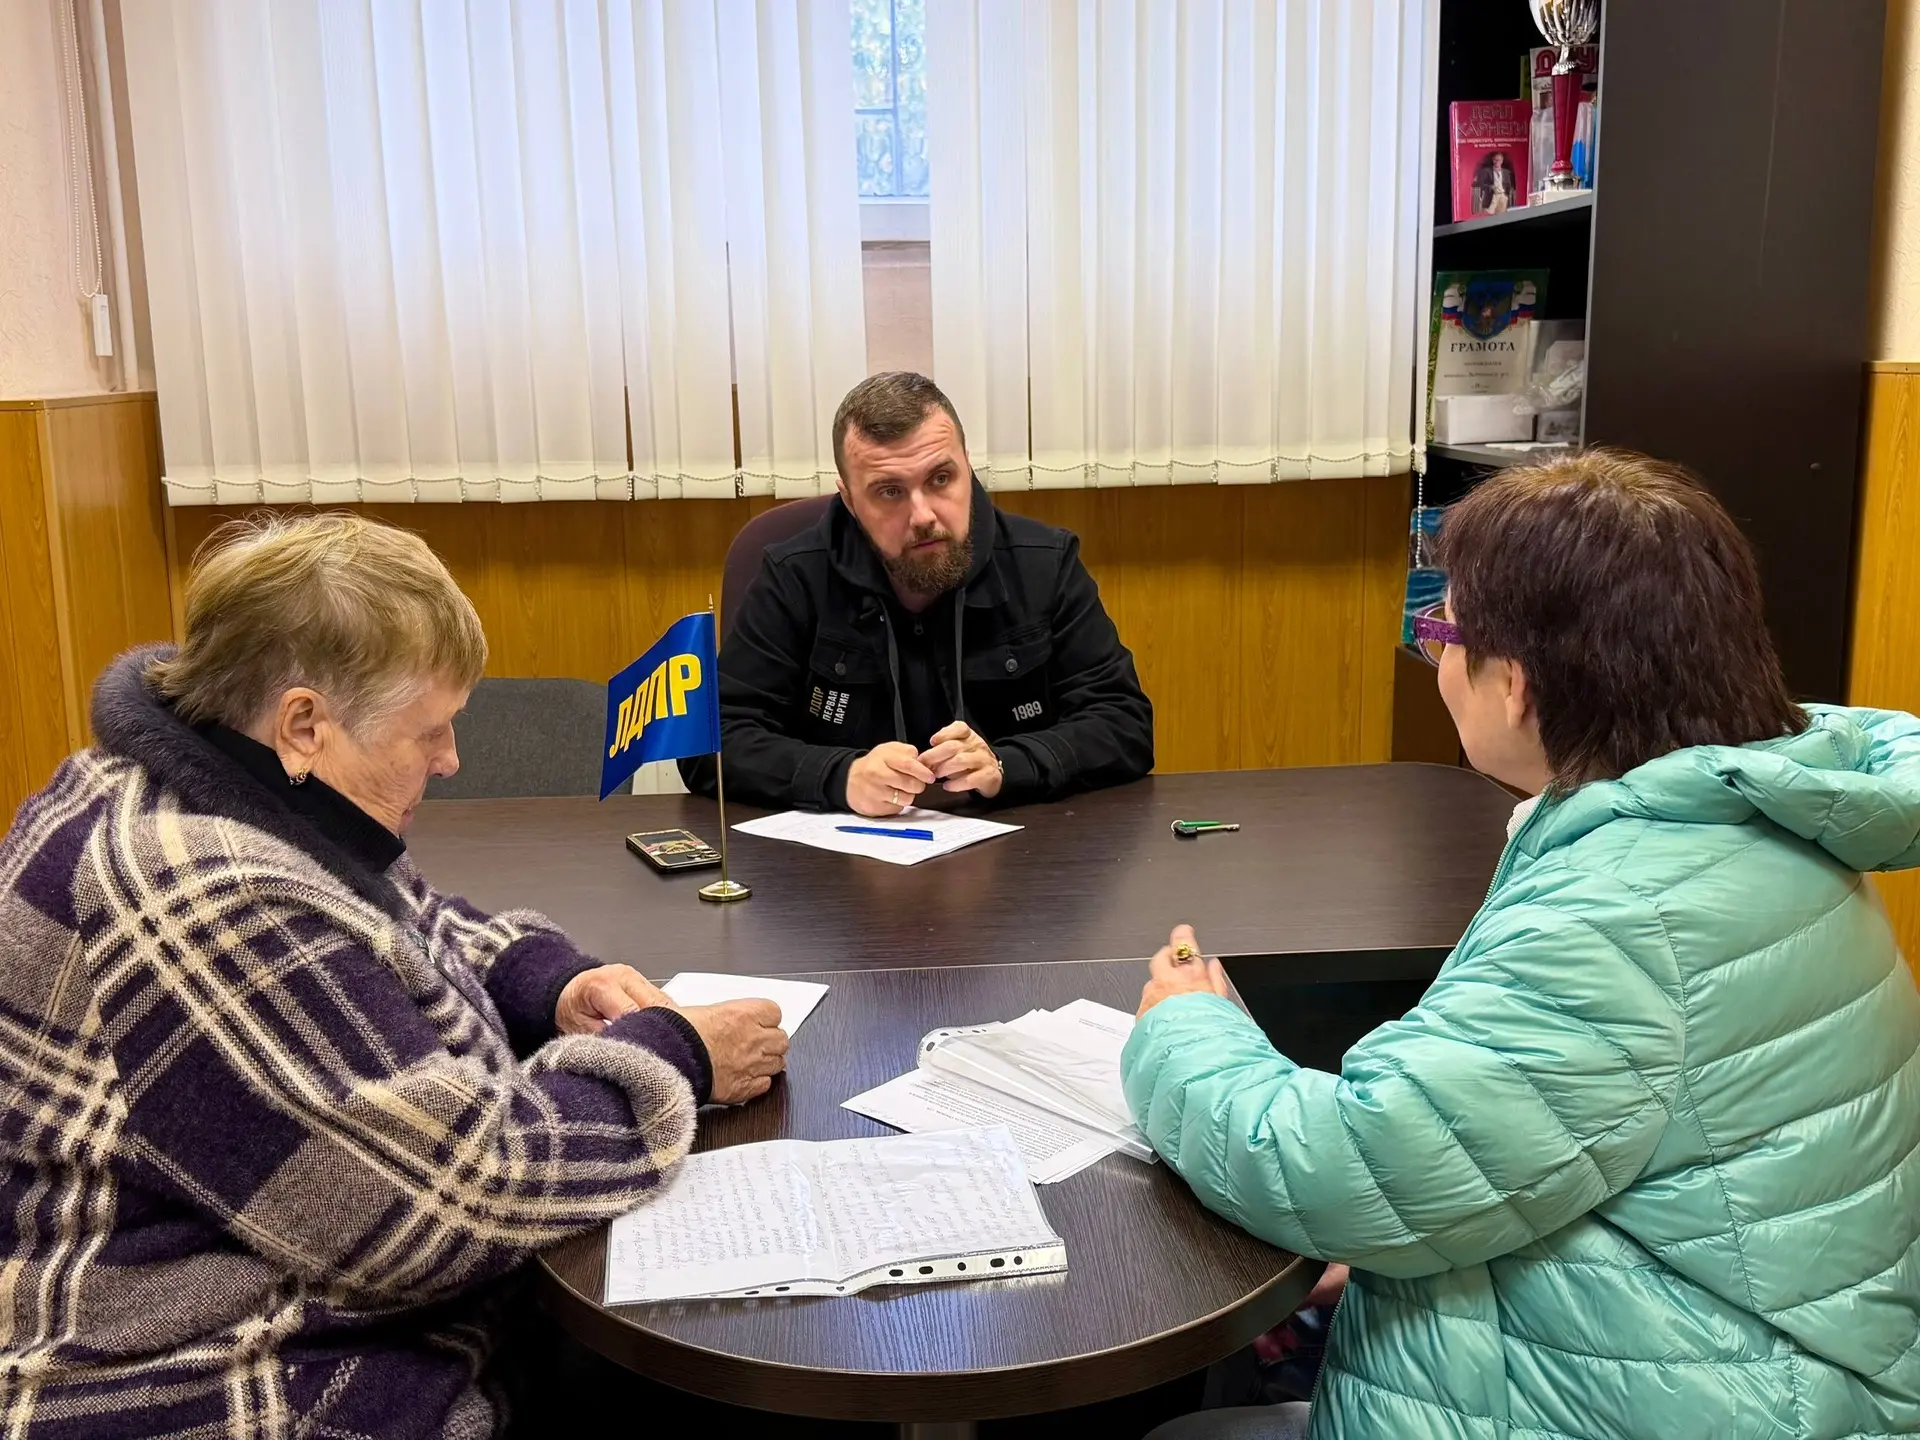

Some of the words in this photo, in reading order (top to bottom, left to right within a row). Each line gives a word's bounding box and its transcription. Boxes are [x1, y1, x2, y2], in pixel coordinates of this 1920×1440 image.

[1469, 104, 1513, 121] ДЕЙЛ
[1457, 120, 1528, 137] КАРНЕГИ
[1450, 341, 1515, 353] ГРАМОТА
[609, 653, 702, 759] ЛДПР
[809, 686, 824, 717] ЛДПР
[822, 690, 839, 722] ПЕРВАЯ
[833, 692, 850, 725] ПАРТИЯ
[1012, 700, 1043, 721] 1989
